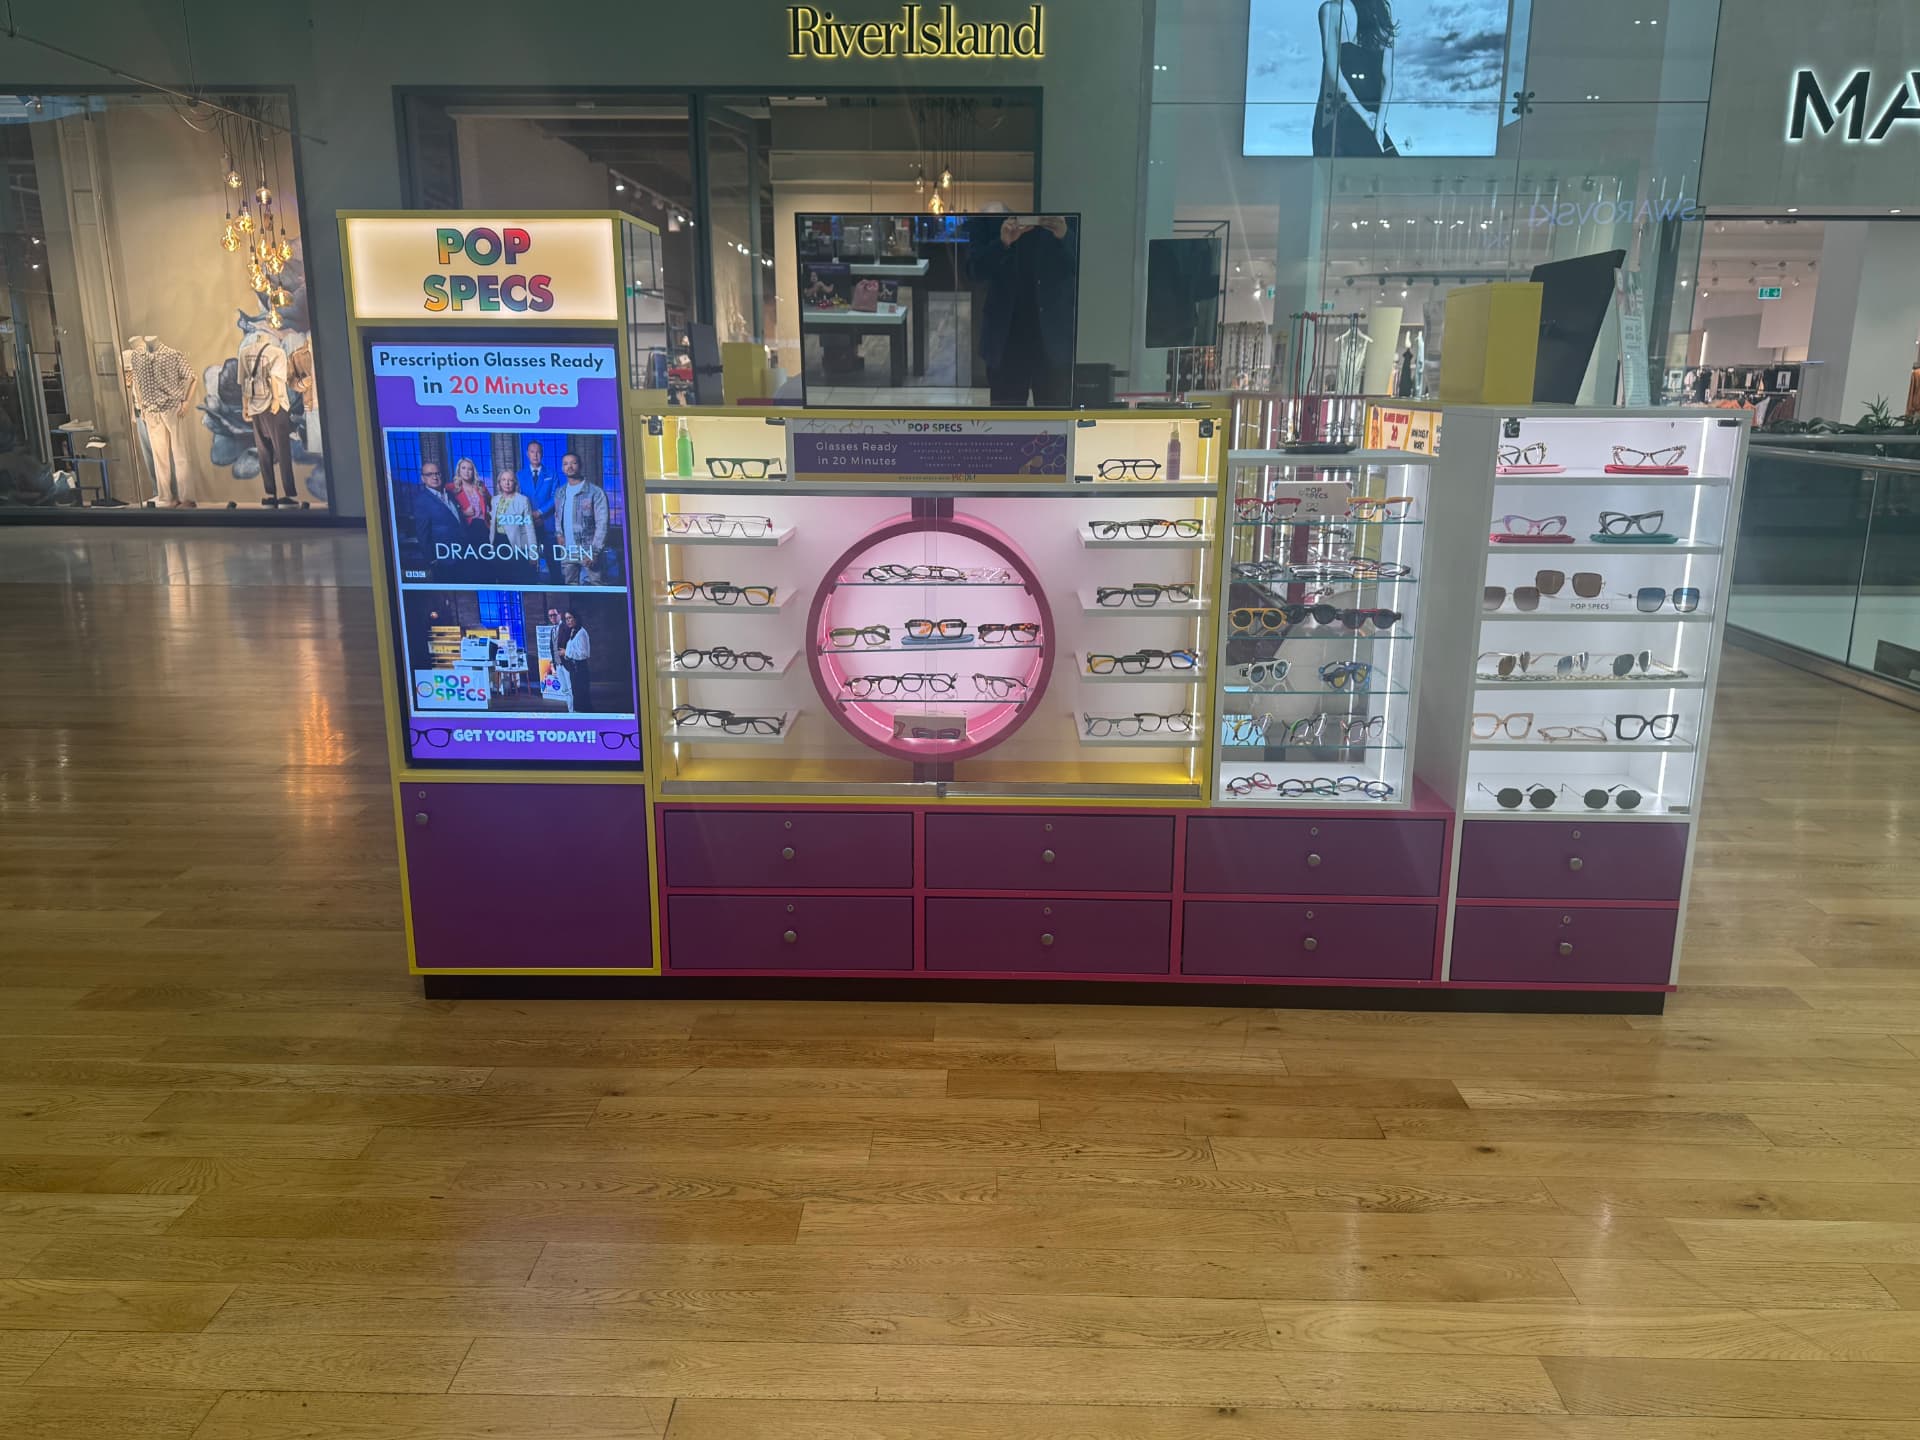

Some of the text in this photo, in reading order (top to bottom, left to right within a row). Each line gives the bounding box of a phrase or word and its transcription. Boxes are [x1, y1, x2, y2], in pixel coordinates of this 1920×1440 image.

[436, 227, 531, 266] POP
[423, 274, 555, 312] SPECS
[380, 352, 604, 372] Prescription Glasses Ready
[423, 375, 569, 395] in 20 Minutes
[464, 404, 531, 416] As Seen On
[907, 423, 963, 433] POP SPECS
[816, 441, 859, 452] Glasses
[862, 442, 898, 454] Ready
[818, 455, 897, 466] in 20 Minutes
[498, 514, 532, 526] 2024
[435, 543, 594, 561] DRAGONS' DEN
[1570, 602, 1586, 610] POP
[433, 674, 471, 688] POP
[435, 688, 487, 702] SPECS
[537, 730, 597, 743] TODAY!!
